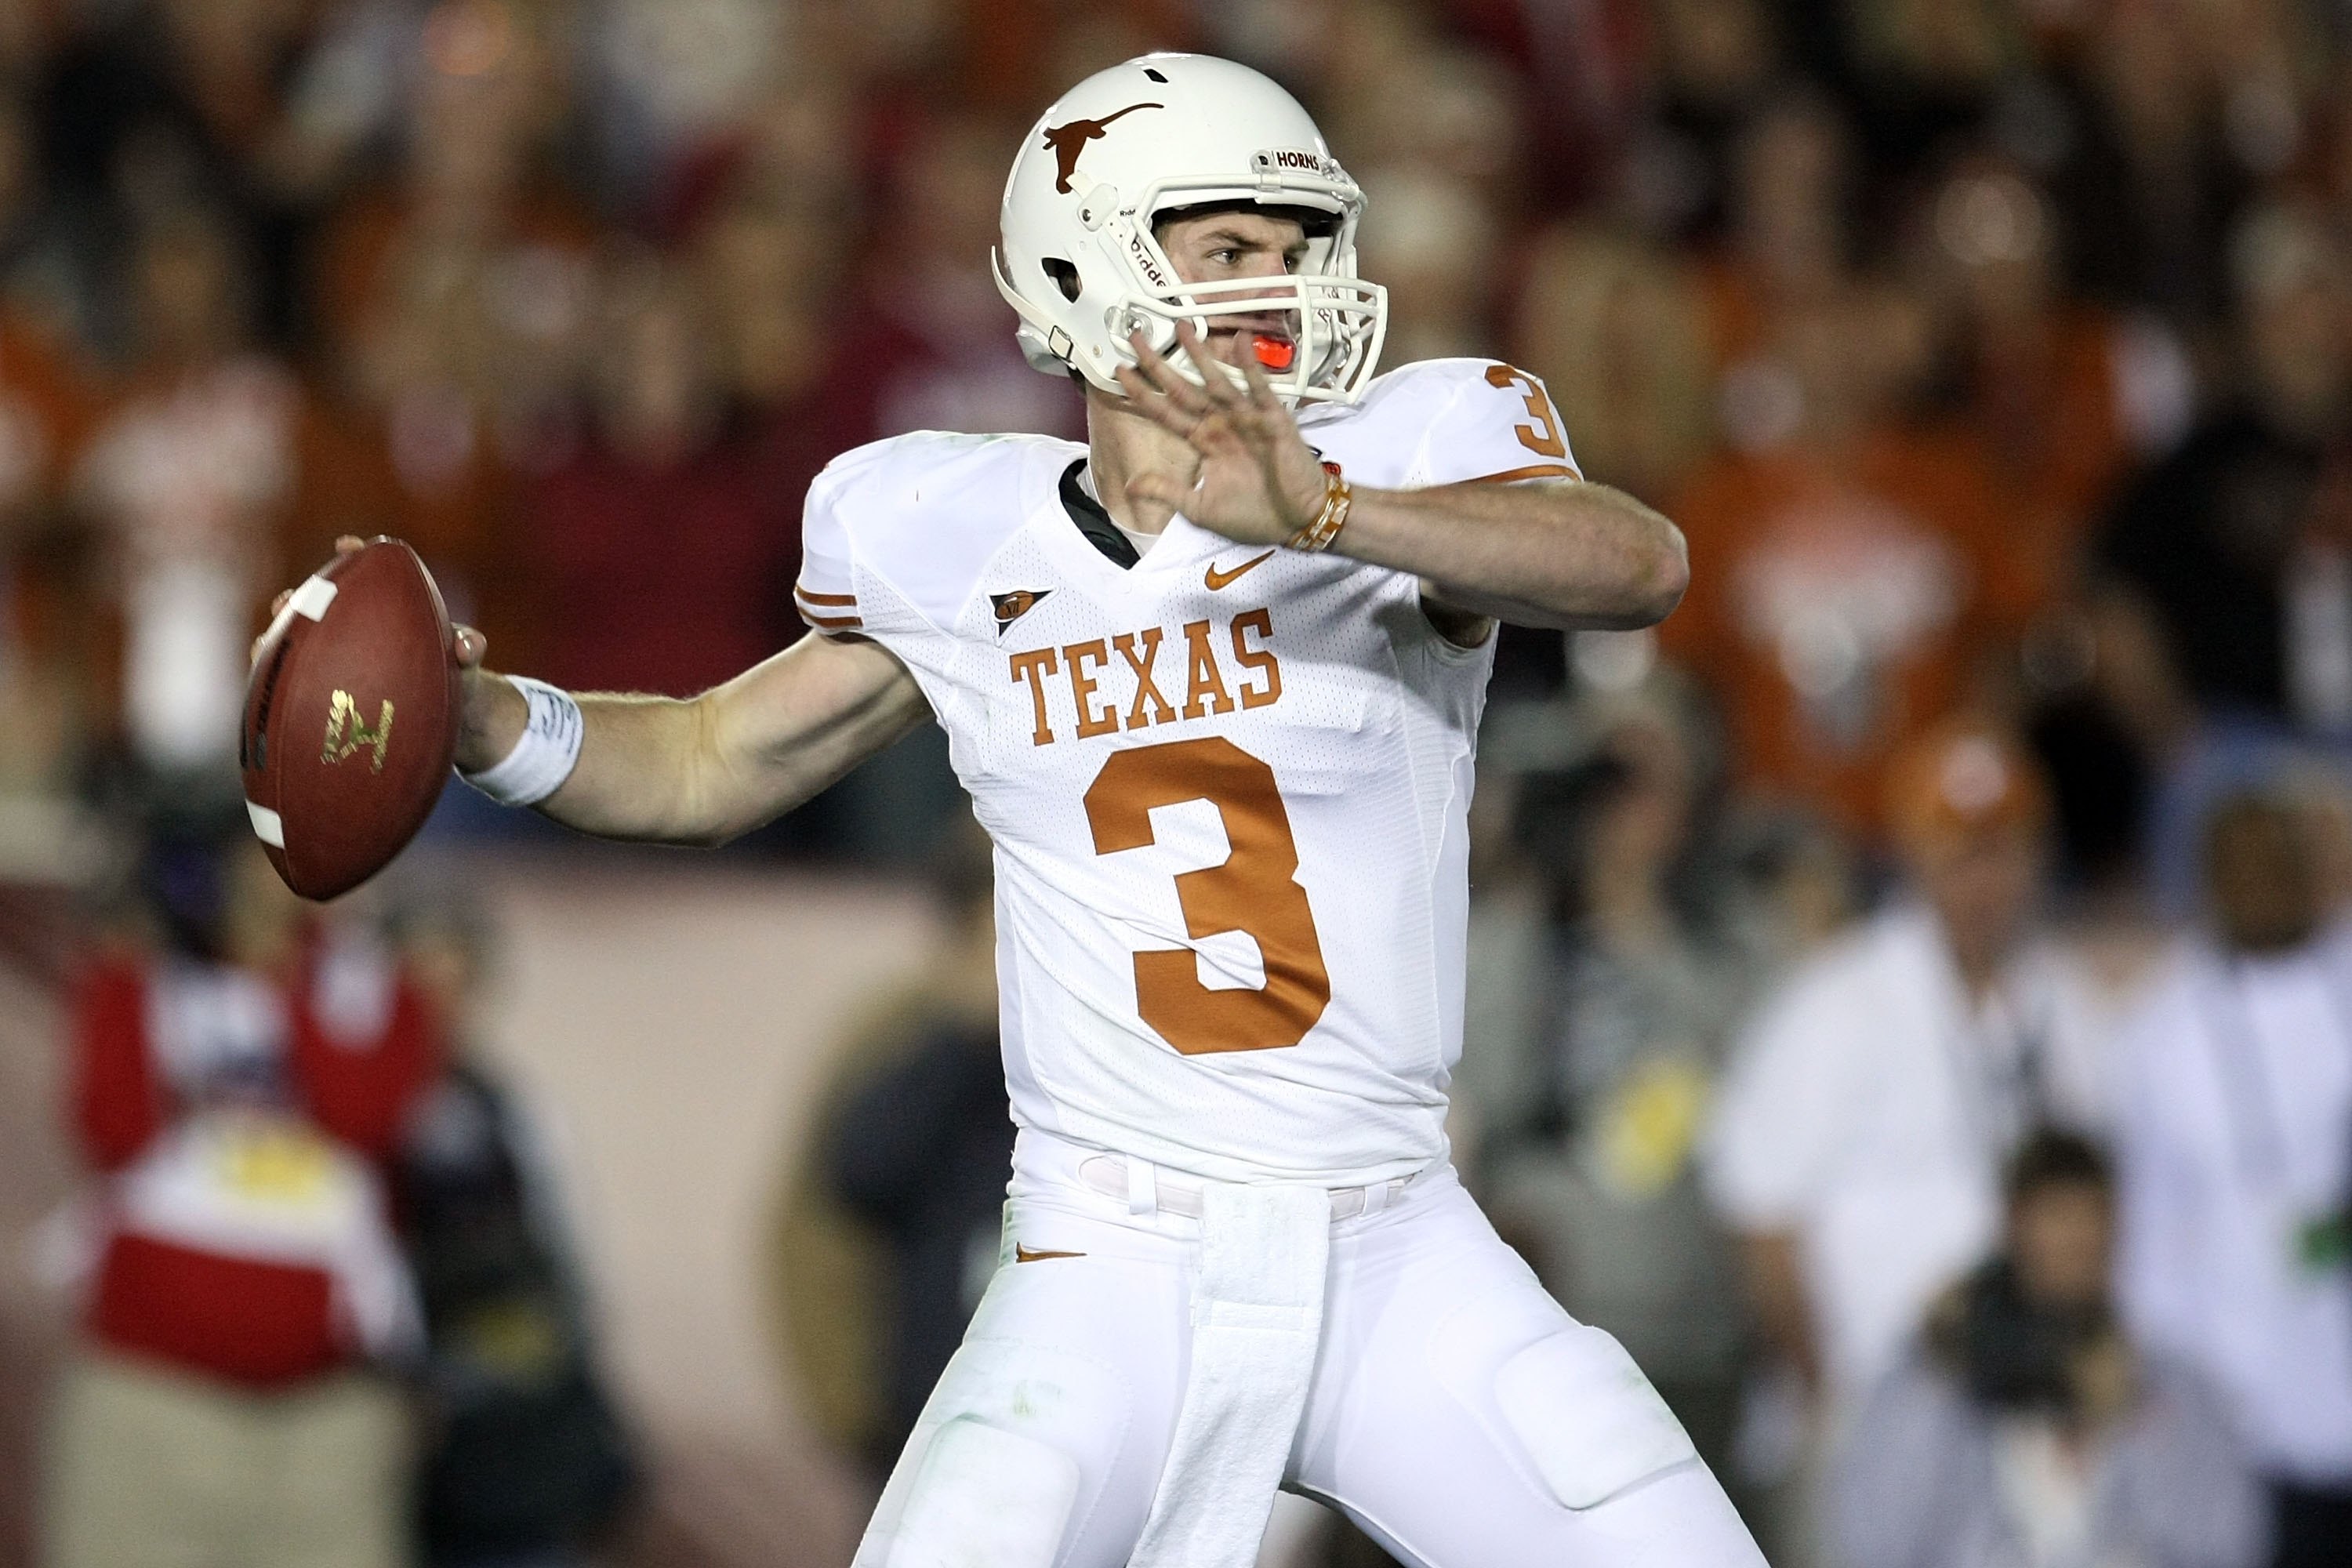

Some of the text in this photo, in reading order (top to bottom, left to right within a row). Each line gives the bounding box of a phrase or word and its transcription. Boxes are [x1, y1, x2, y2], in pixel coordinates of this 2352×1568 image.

[1276, 151, 1319, 171] HORNS
[1484, 365, 1566, 459] 3
[1010, 608, 1283, 746] TEXAS
[1083, 736, 1330, 1055] 3
